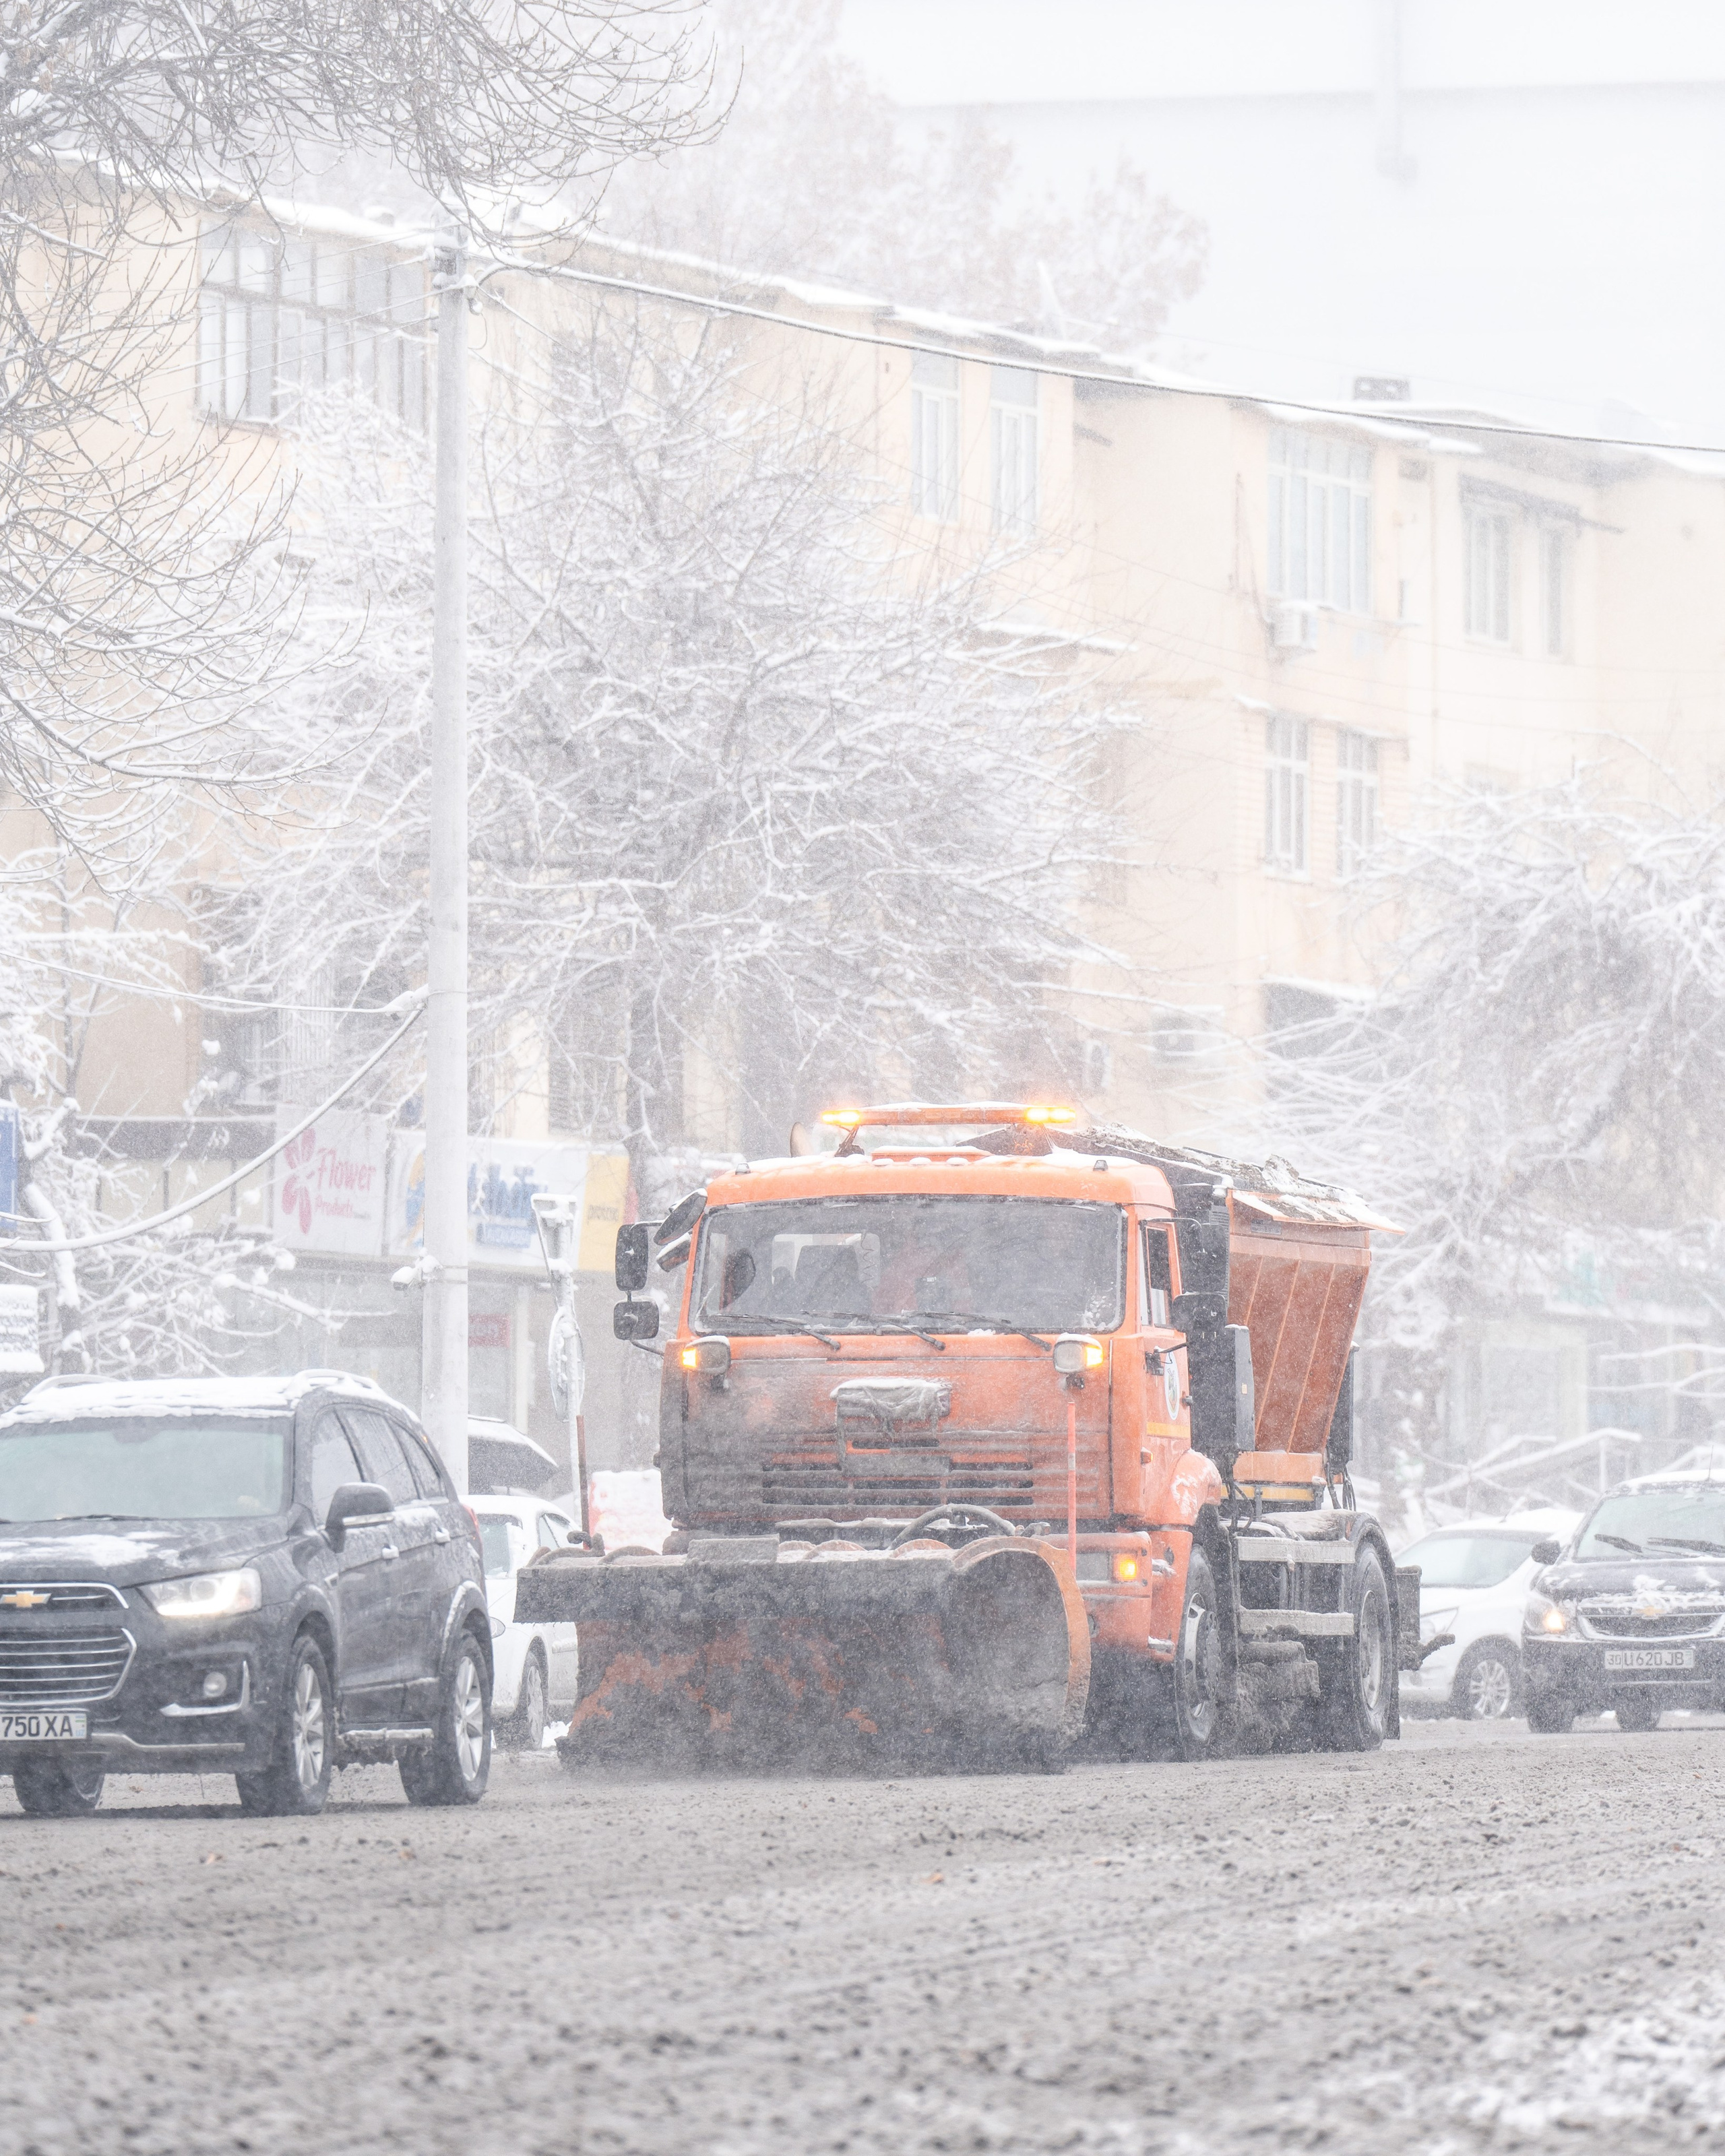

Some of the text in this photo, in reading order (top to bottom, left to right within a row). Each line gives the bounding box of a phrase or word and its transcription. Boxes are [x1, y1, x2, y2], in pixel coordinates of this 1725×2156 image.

[317, 1147, 377, 1192] Flower
[1636, 1652, 1663, 1666] 620
[1664, 1651, 1684, 1666] JB
[1, 1715, 73, 1738] 750 XA
